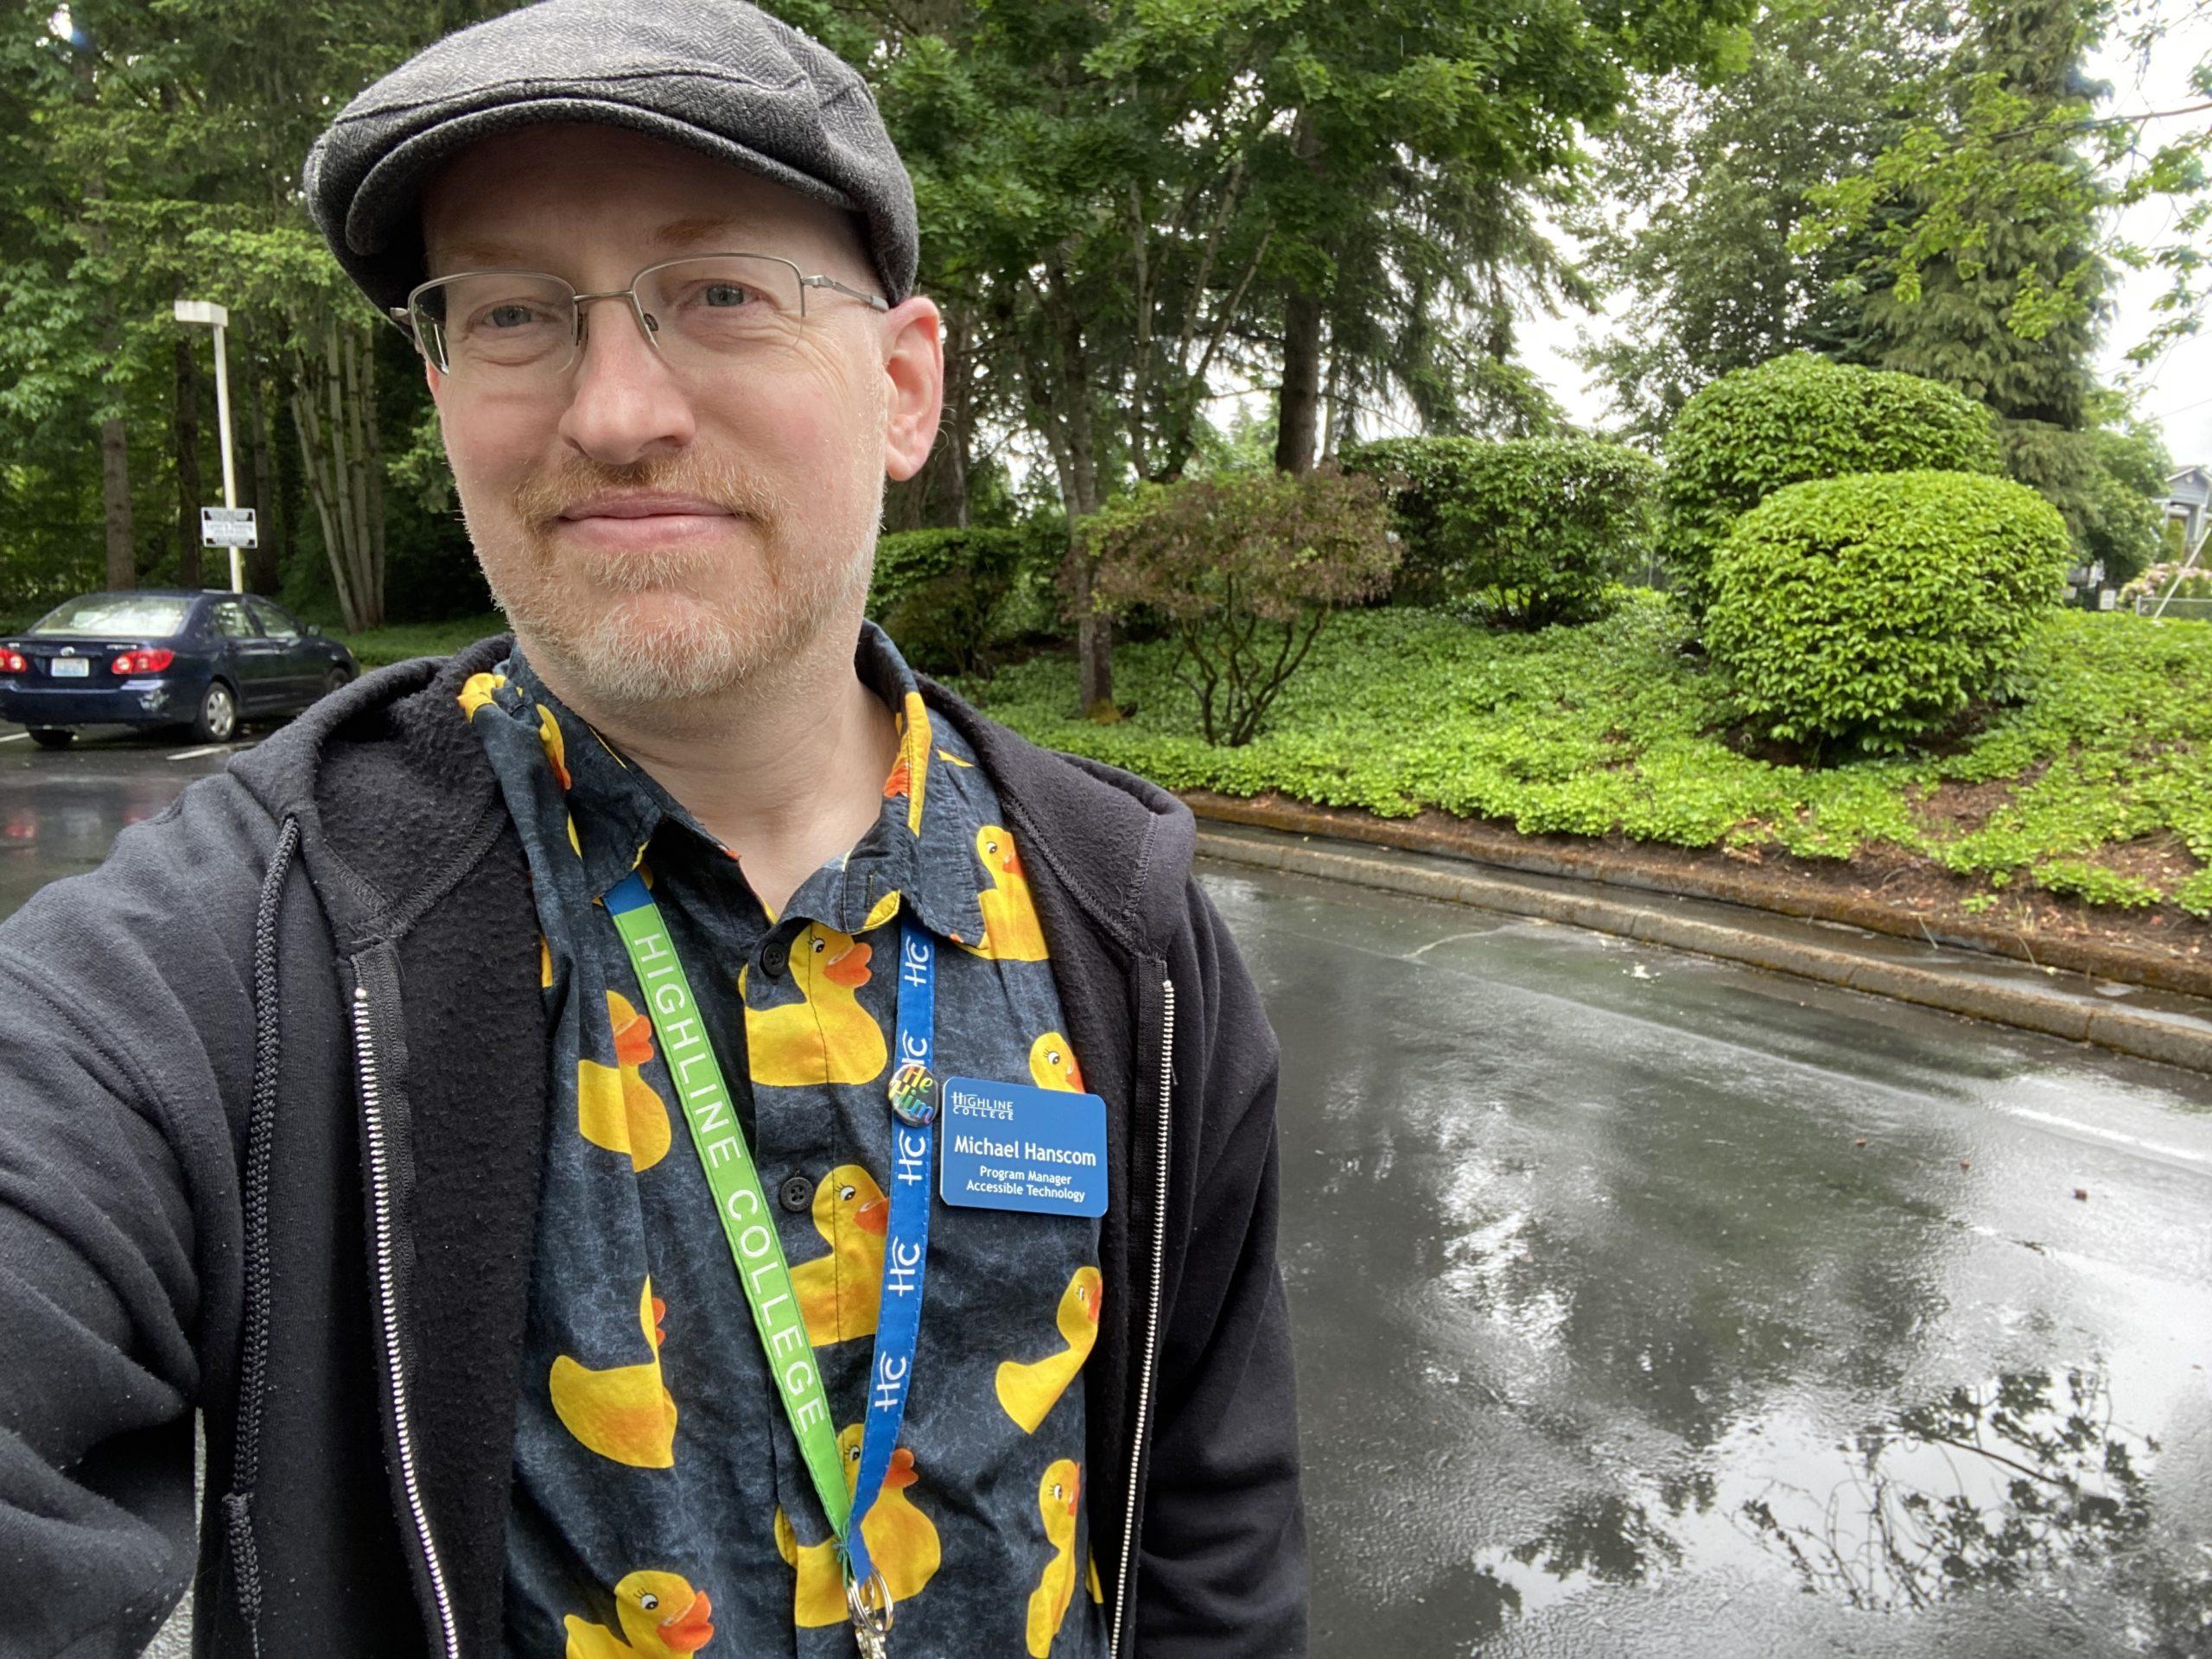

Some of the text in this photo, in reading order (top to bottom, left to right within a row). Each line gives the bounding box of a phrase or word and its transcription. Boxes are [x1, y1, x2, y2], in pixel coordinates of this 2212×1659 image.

[904, 936, 929, 987] HC
[902, 1065, 933, 1093] He
[887, 1079, 934, 1124] Him
[951, 1091, 1014, 1112] HIGHLINE
[953, 1107, 1014, 1121] COLLEGE
[898, 1128, 926, 1186] HC
[954, 1135, 1096, 1166] Michael Hanscom
[634, 933, 825, 1433] HIGHLINE COLLEGE
[966, 1179, 1085, 1204] Accessible Technology
[980, 1166, 1072, 1186] Program Manager
[888, 1236, 920, 1297] HC
[874, 1351, 907, 1413] HC
